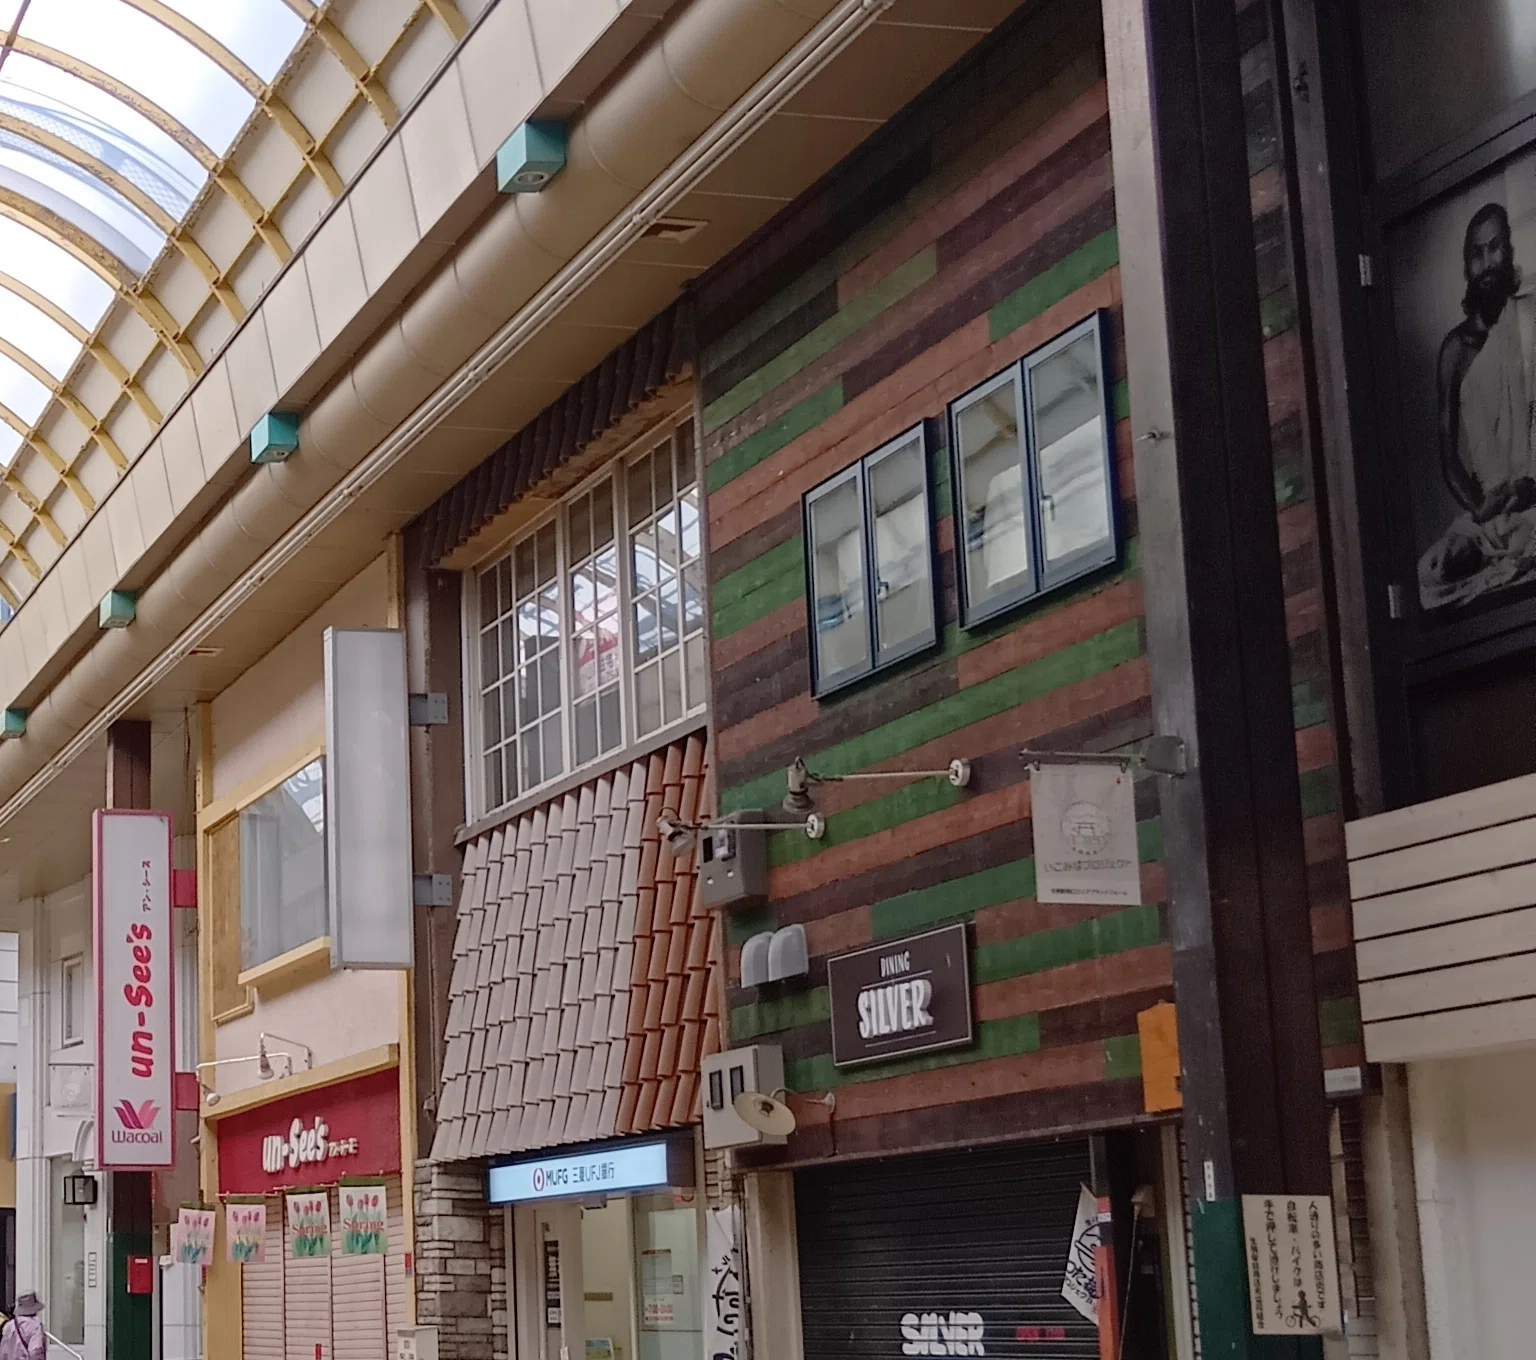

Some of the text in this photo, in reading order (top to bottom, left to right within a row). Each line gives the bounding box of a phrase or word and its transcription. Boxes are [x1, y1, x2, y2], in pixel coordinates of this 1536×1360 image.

[880, 950, 910, 978] DINING
[857, 979, 934, 1039] SILVER
[111, 1130, 162, 1144] Wacoal
[546, 1169, 568, 1186] MUFG
[292, 1222, 328, 1237] Spring
[343, 1217, 384, 1233] Spring
[900, 1311, 985, 1356] SILVER
